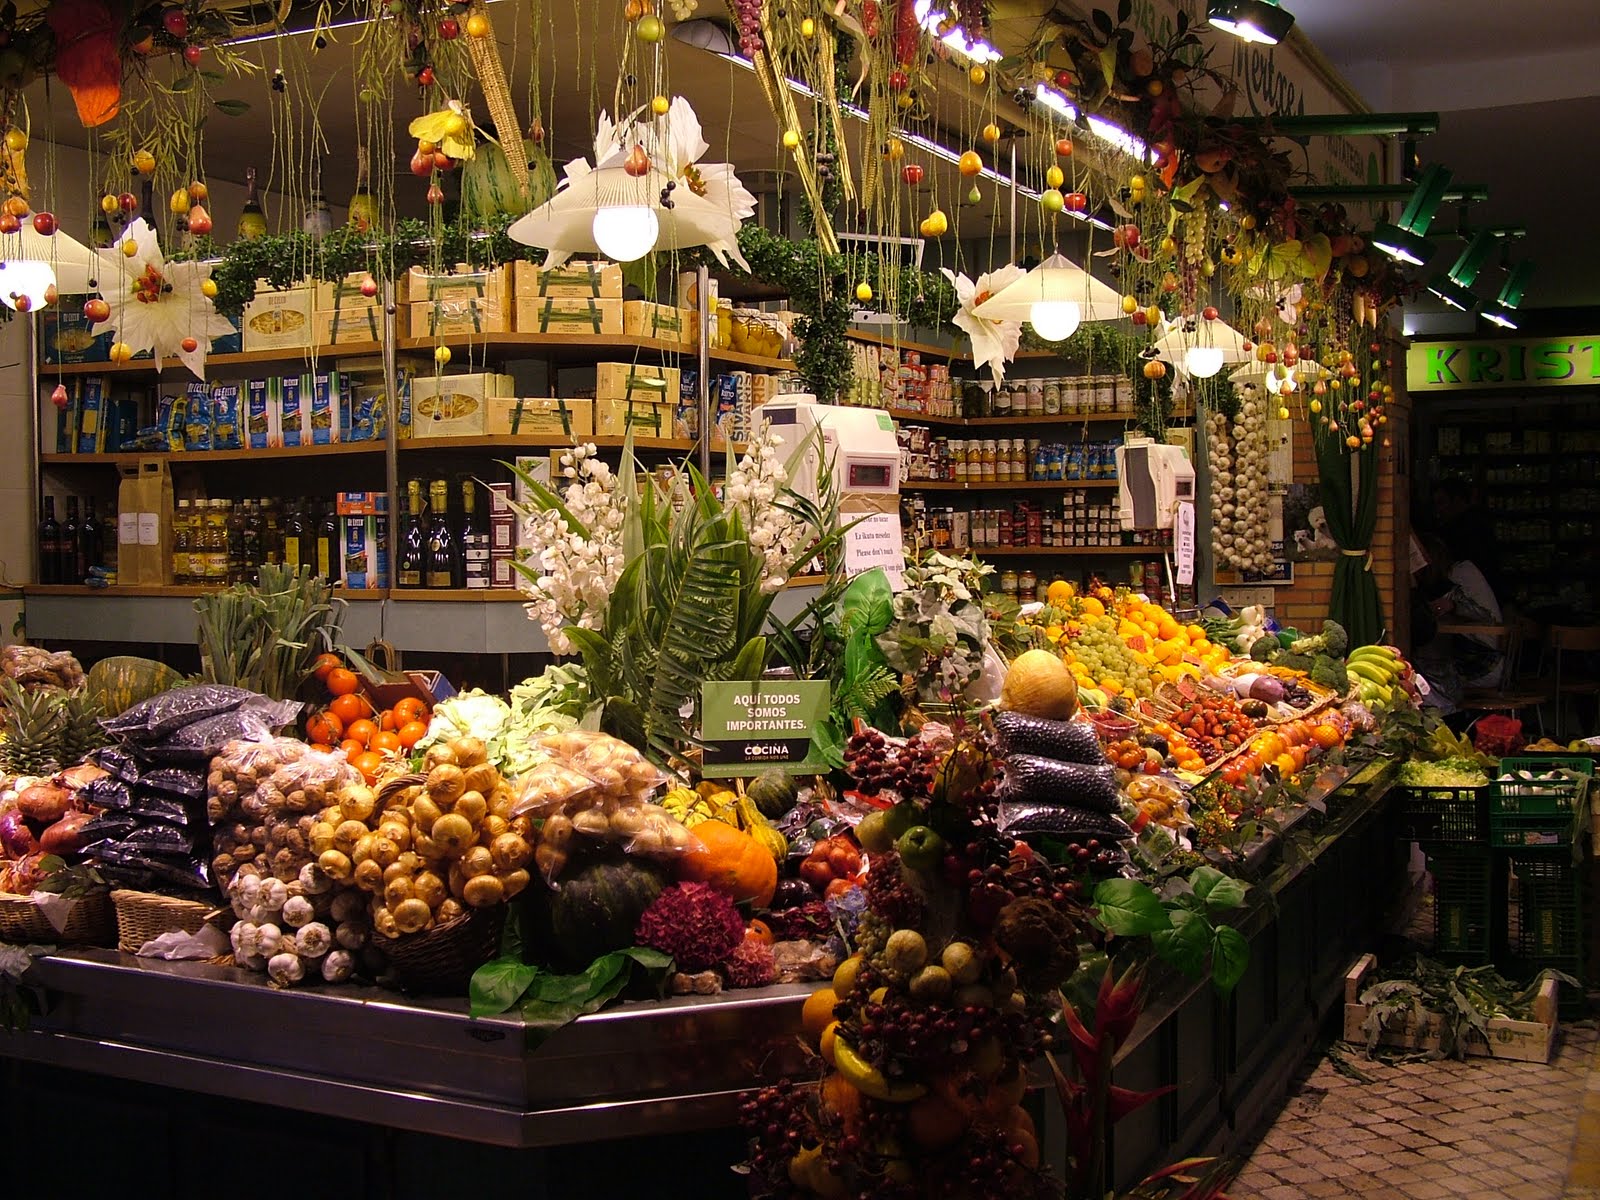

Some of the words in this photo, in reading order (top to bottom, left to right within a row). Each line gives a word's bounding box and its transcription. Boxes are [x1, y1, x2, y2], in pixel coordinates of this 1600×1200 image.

[732, 374, 744, 442] SIVARIS
[856, 549, 871, 557] Please
[733, 692, 762, 707] AQUÍ
[763, 694, 801, 705] TODOS
[747, 707, 787, 718] SOMOS
[726, 719, 807, 731] IMPORTANTES.
[744, 745, 789, 756] COCINA
